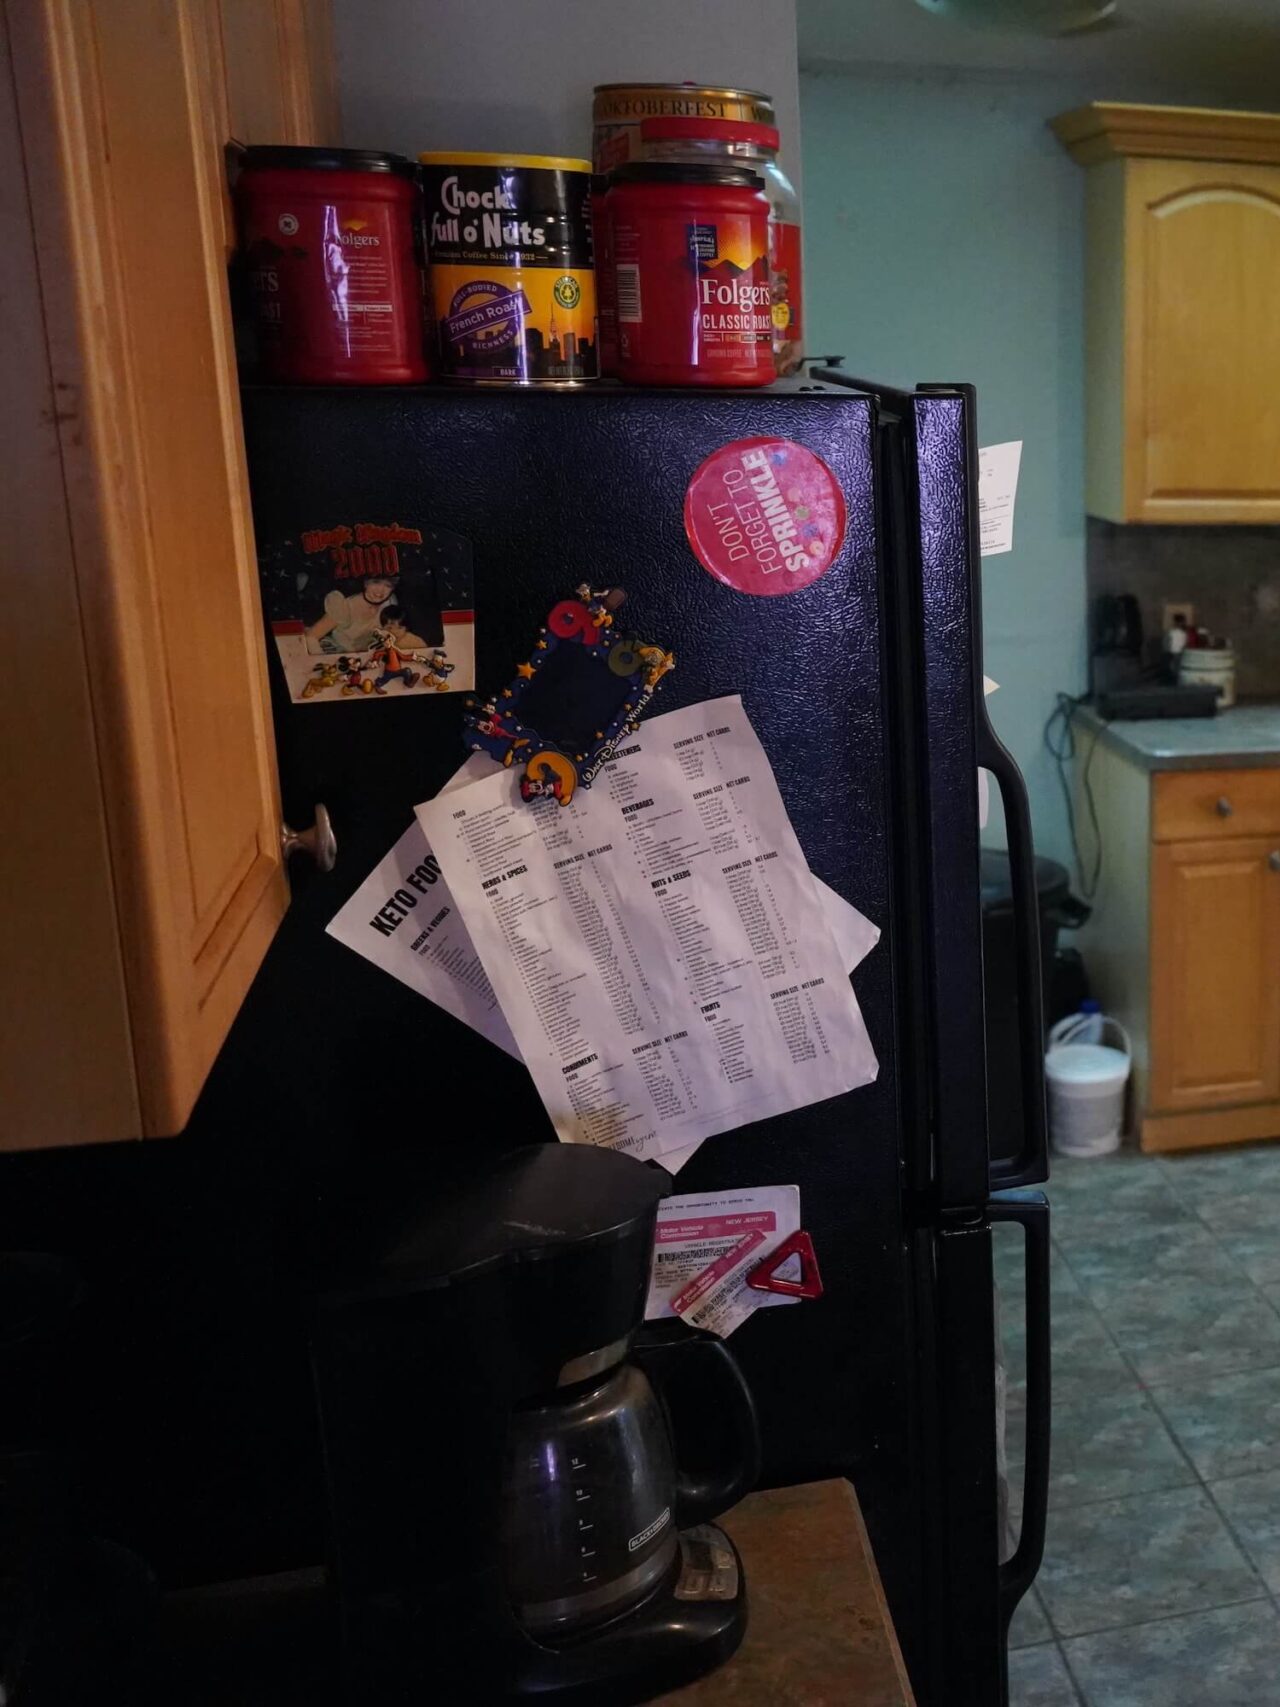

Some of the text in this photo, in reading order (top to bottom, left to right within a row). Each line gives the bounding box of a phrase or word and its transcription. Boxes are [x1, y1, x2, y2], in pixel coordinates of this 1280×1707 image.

[601, 98, 726, 117] OKTOBERFEST
[441, 175, 513, 215] Chock
[430, 211, 545, 249] full o' Nuts
[701, 278, 770, 313] Folgers
[450, 311, 485, 335] French
[702, 314, 749, 330] CLASSIC
[472, 330, 514, 350] RICHNESS
[500, 368, 517, 376] DARK
[741, 448, 810, 573] SPRINKLE
[723, 469, 782, 575] FORGET TO
[707, 503, 750, 562] DON'T
[607, 745, 641, 761] EETENERS
[582, 756, 605, 783] Walt
[605, 764, 617, 772] FOOD
[622, 799, 654, 814] BEVERAGES
[482, 876, 502, 889] HERBS
[507, 865, 528, 878] SPICES
[652, 878, 667, 888] NUTS
[673, 870, 691, 880] SEEDS
[369, 854, 443, 938] KETO FOO
[410, 930, 429, 951] GREENS
[701, 1002, 720, 1013] FRUITS
[561, 1053, 600, 1073] CONDIMENTS
[725, 1215, 768, 1225] NEW JERSEY
